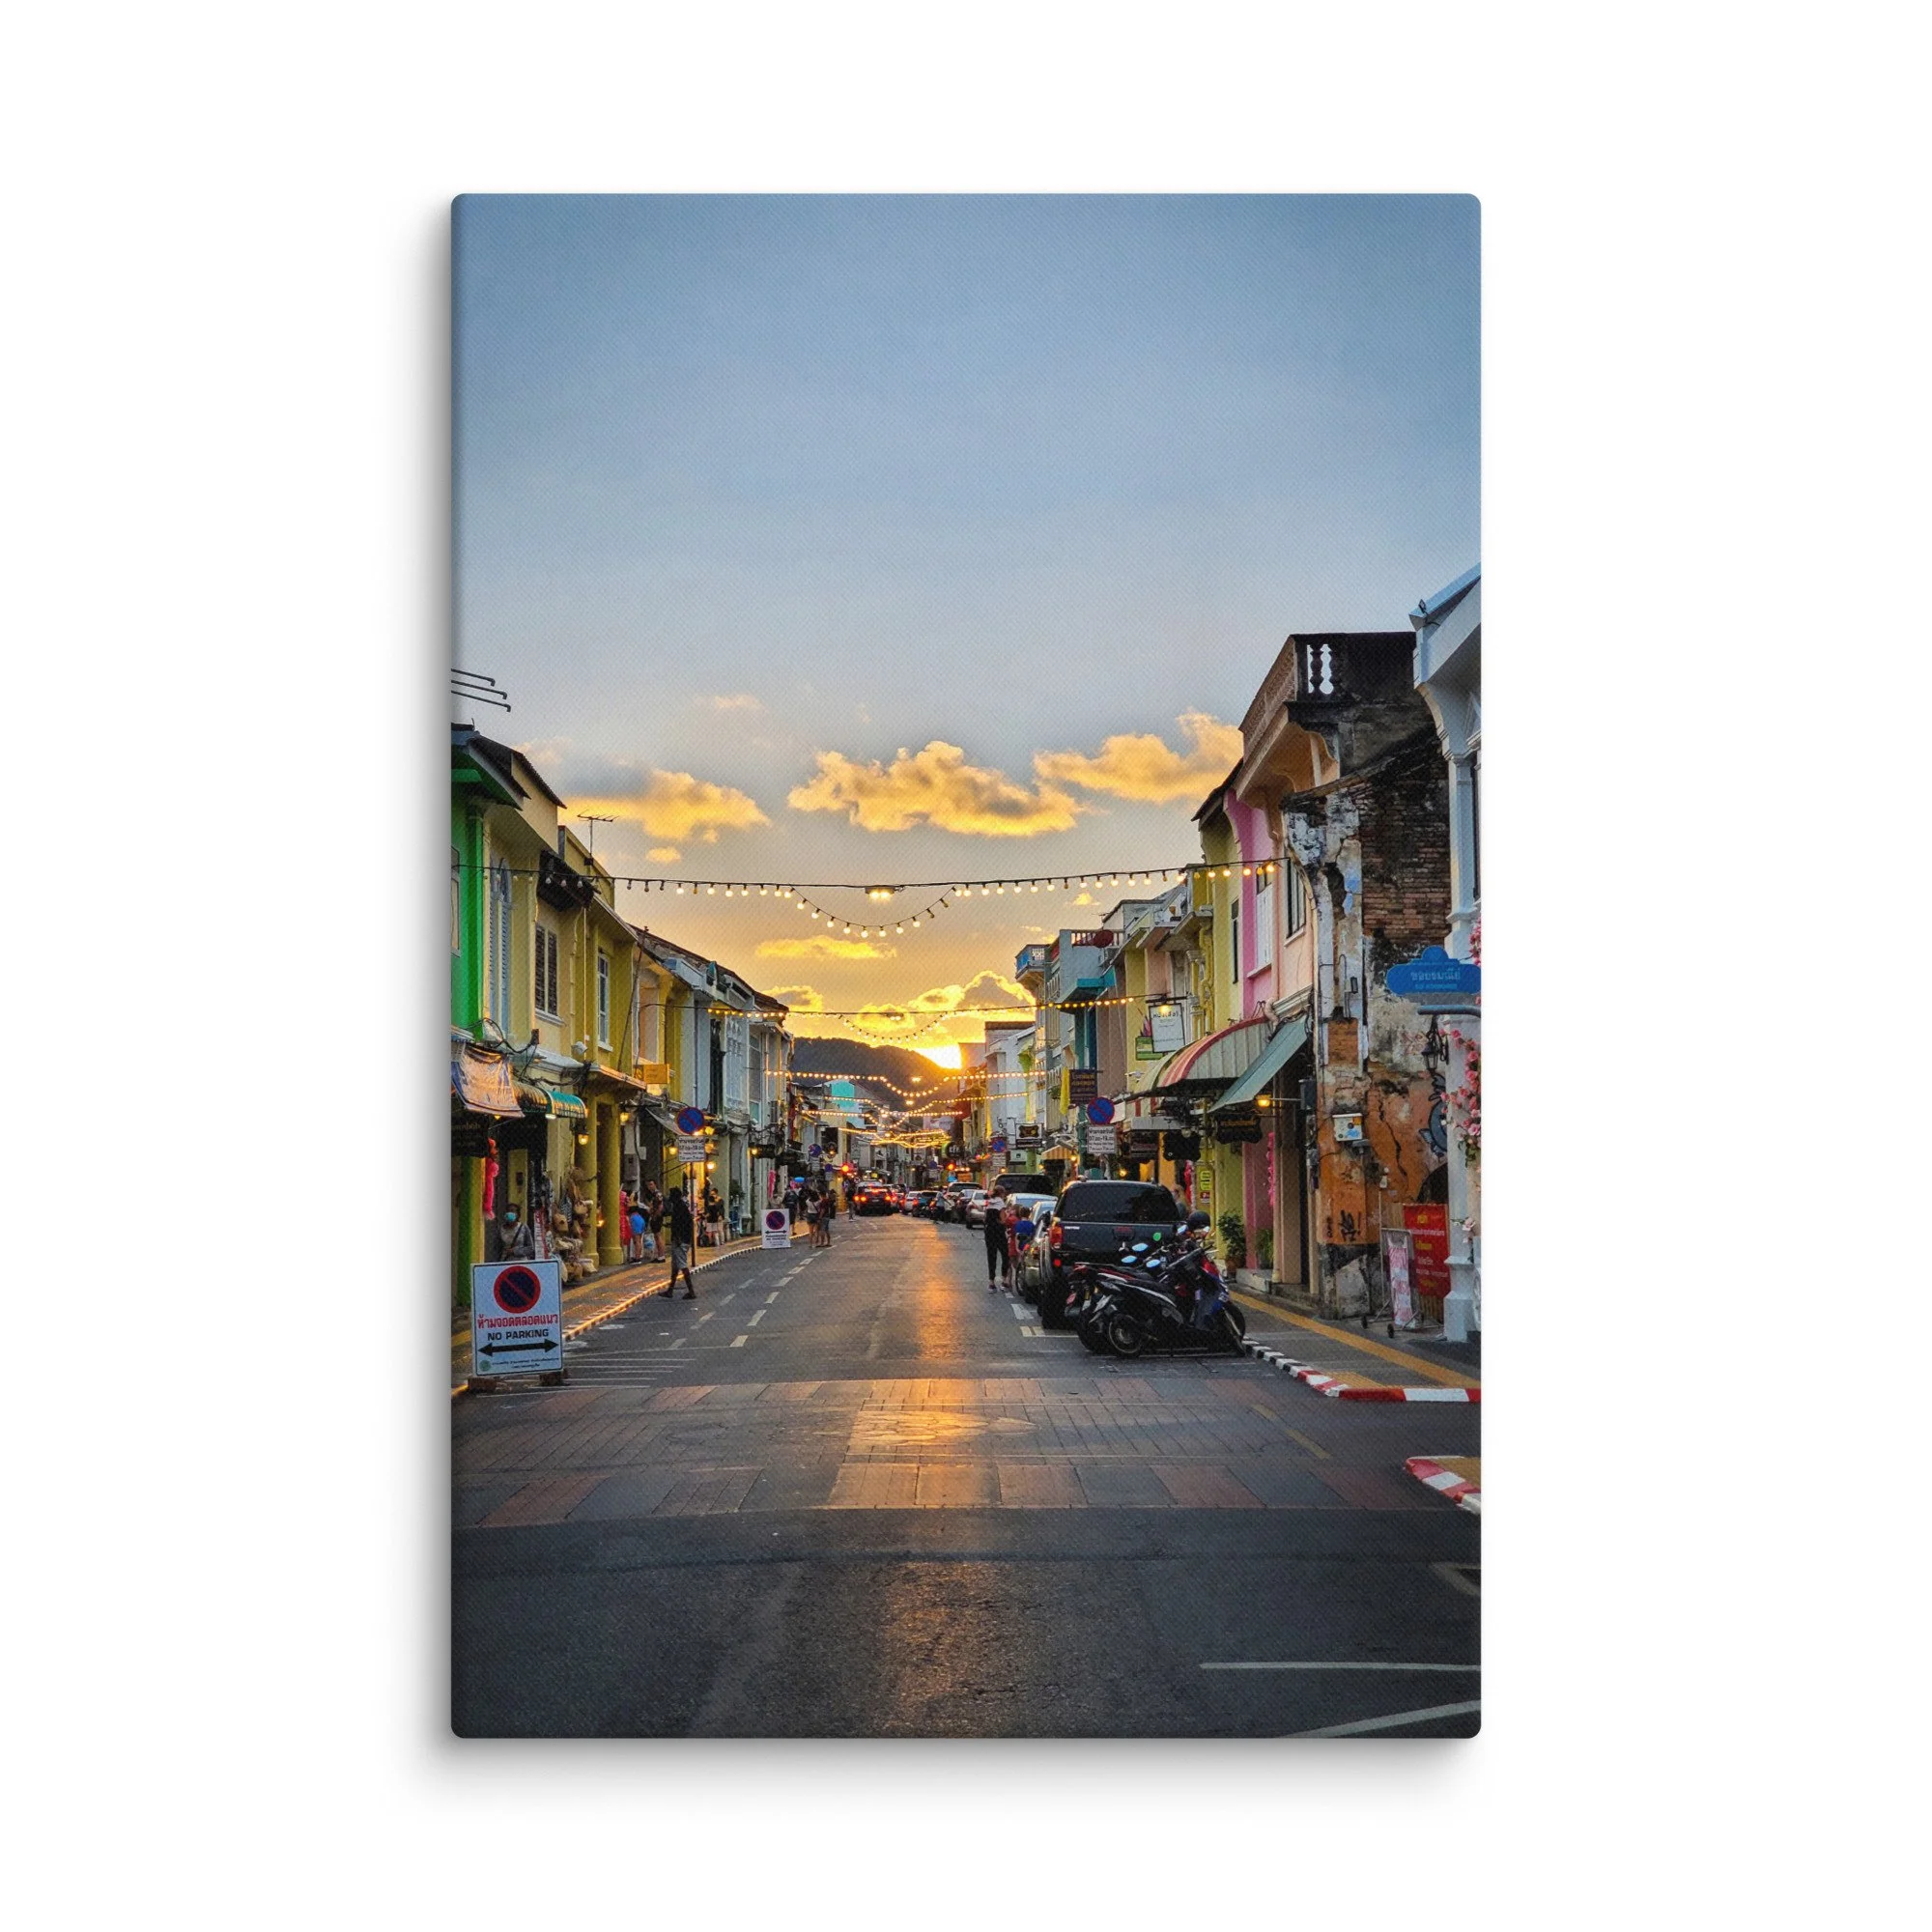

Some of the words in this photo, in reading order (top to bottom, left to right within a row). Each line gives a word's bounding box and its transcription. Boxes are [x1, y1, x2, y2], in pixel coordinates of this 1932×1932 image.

[477, 1314, 558, 1329] ห้ามจอดตลอดแนว
[488, 1332, 502, 1341] NO
[506, 1329, 549, 1340] PARKING
